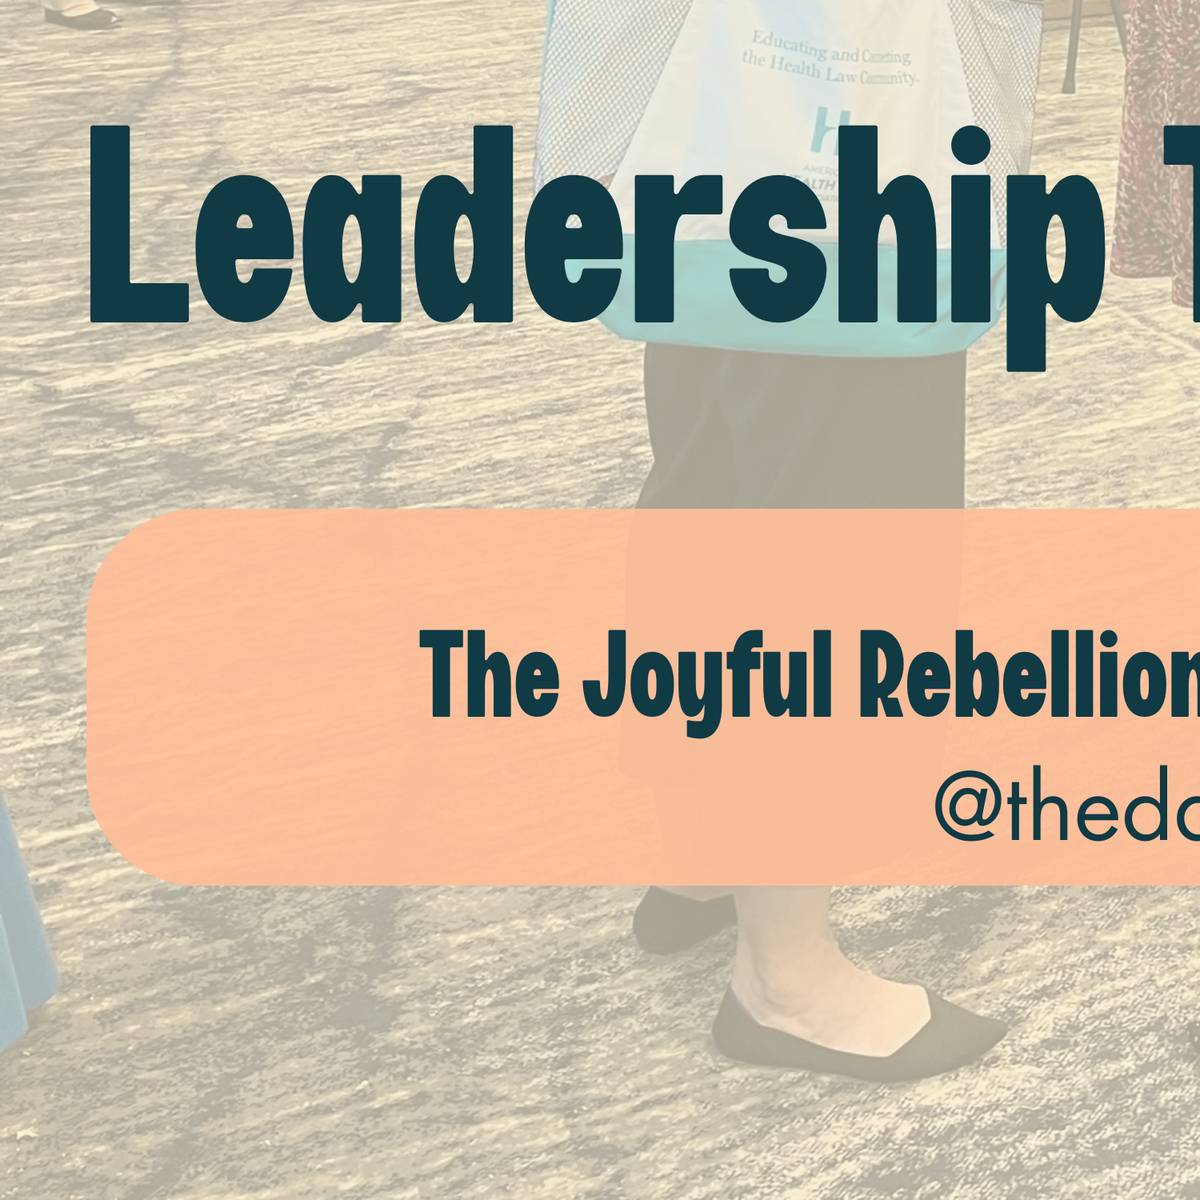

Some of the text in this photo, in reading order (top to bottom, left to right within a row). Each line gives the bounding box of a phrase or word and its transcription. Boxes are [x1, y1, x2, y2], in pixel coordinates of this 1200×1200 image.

[752, 29, 829, 63] Educating
[831, 47, 860, 63] and
[742, 49, 766, 68] the
[769, 54, 821, 80] Health
[824, 66, 858, 83] Law
